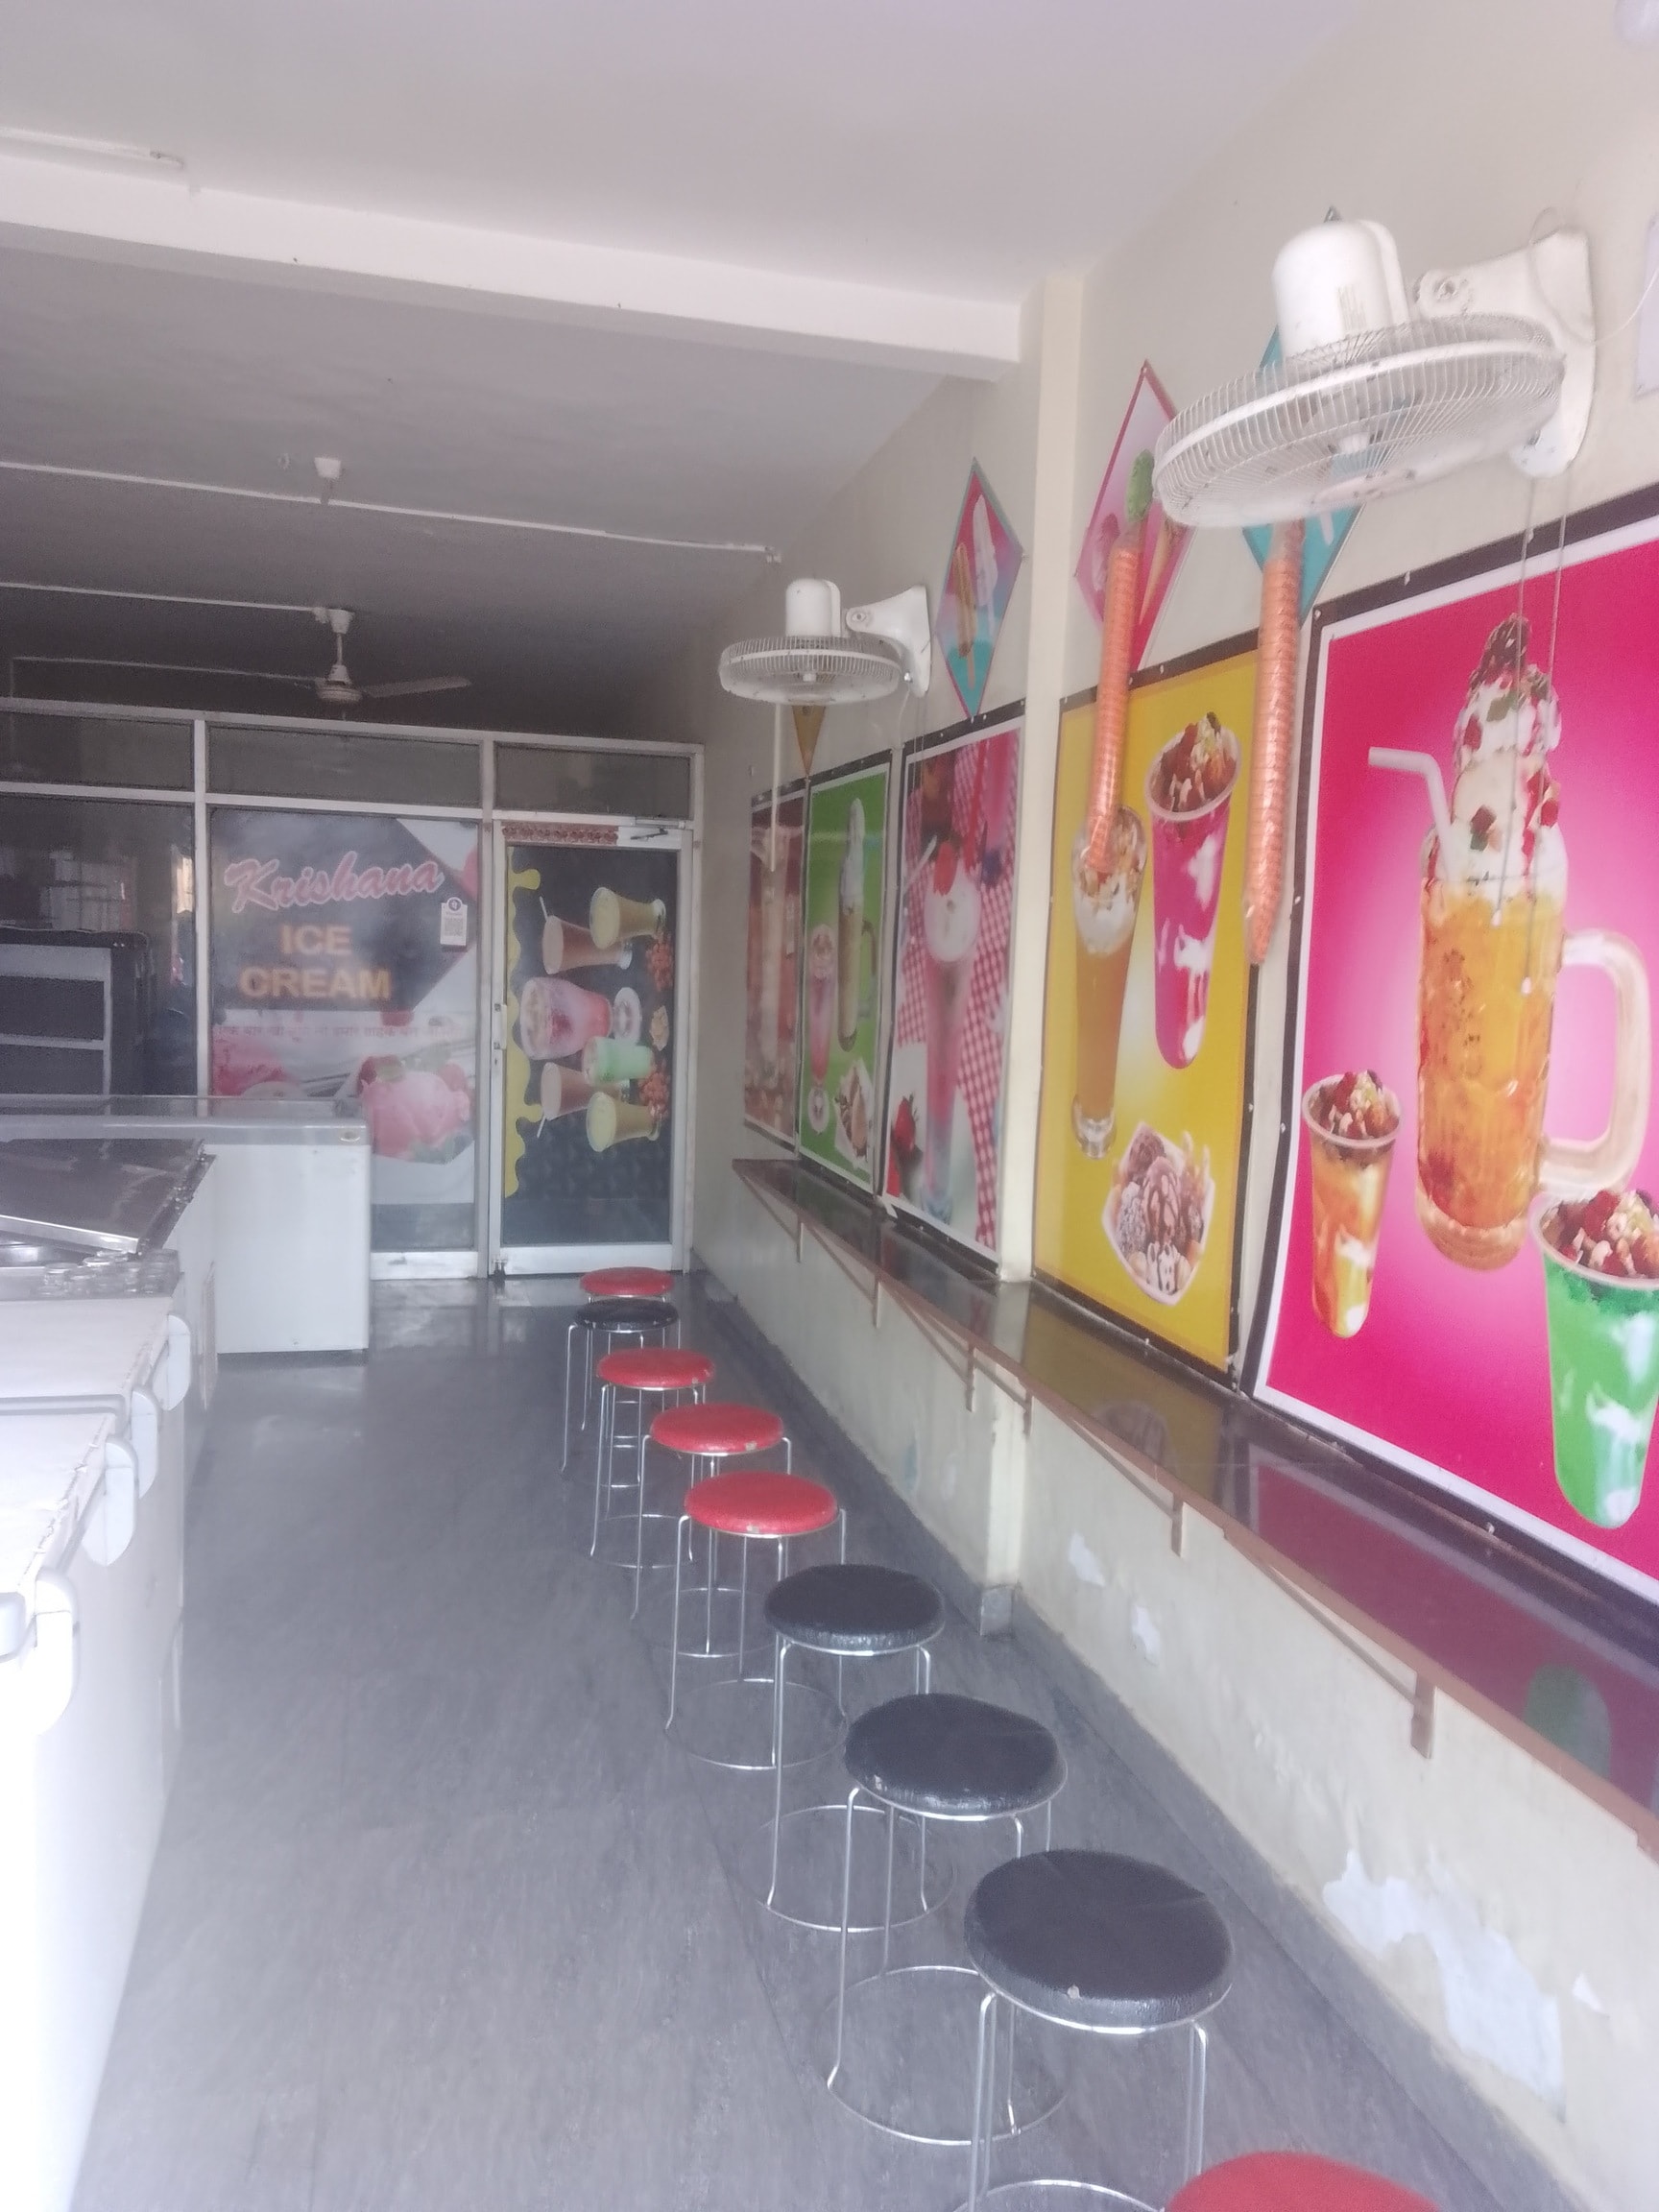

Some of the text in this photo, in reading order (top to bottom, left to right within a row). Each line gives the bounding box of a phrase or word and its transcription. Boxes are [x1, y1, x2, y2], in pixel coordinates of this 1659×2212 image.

[225, 851, 444, 913] Krishana
[280, 924, 351, 955] ICE
[239, 965, 392, 999] CREAM
